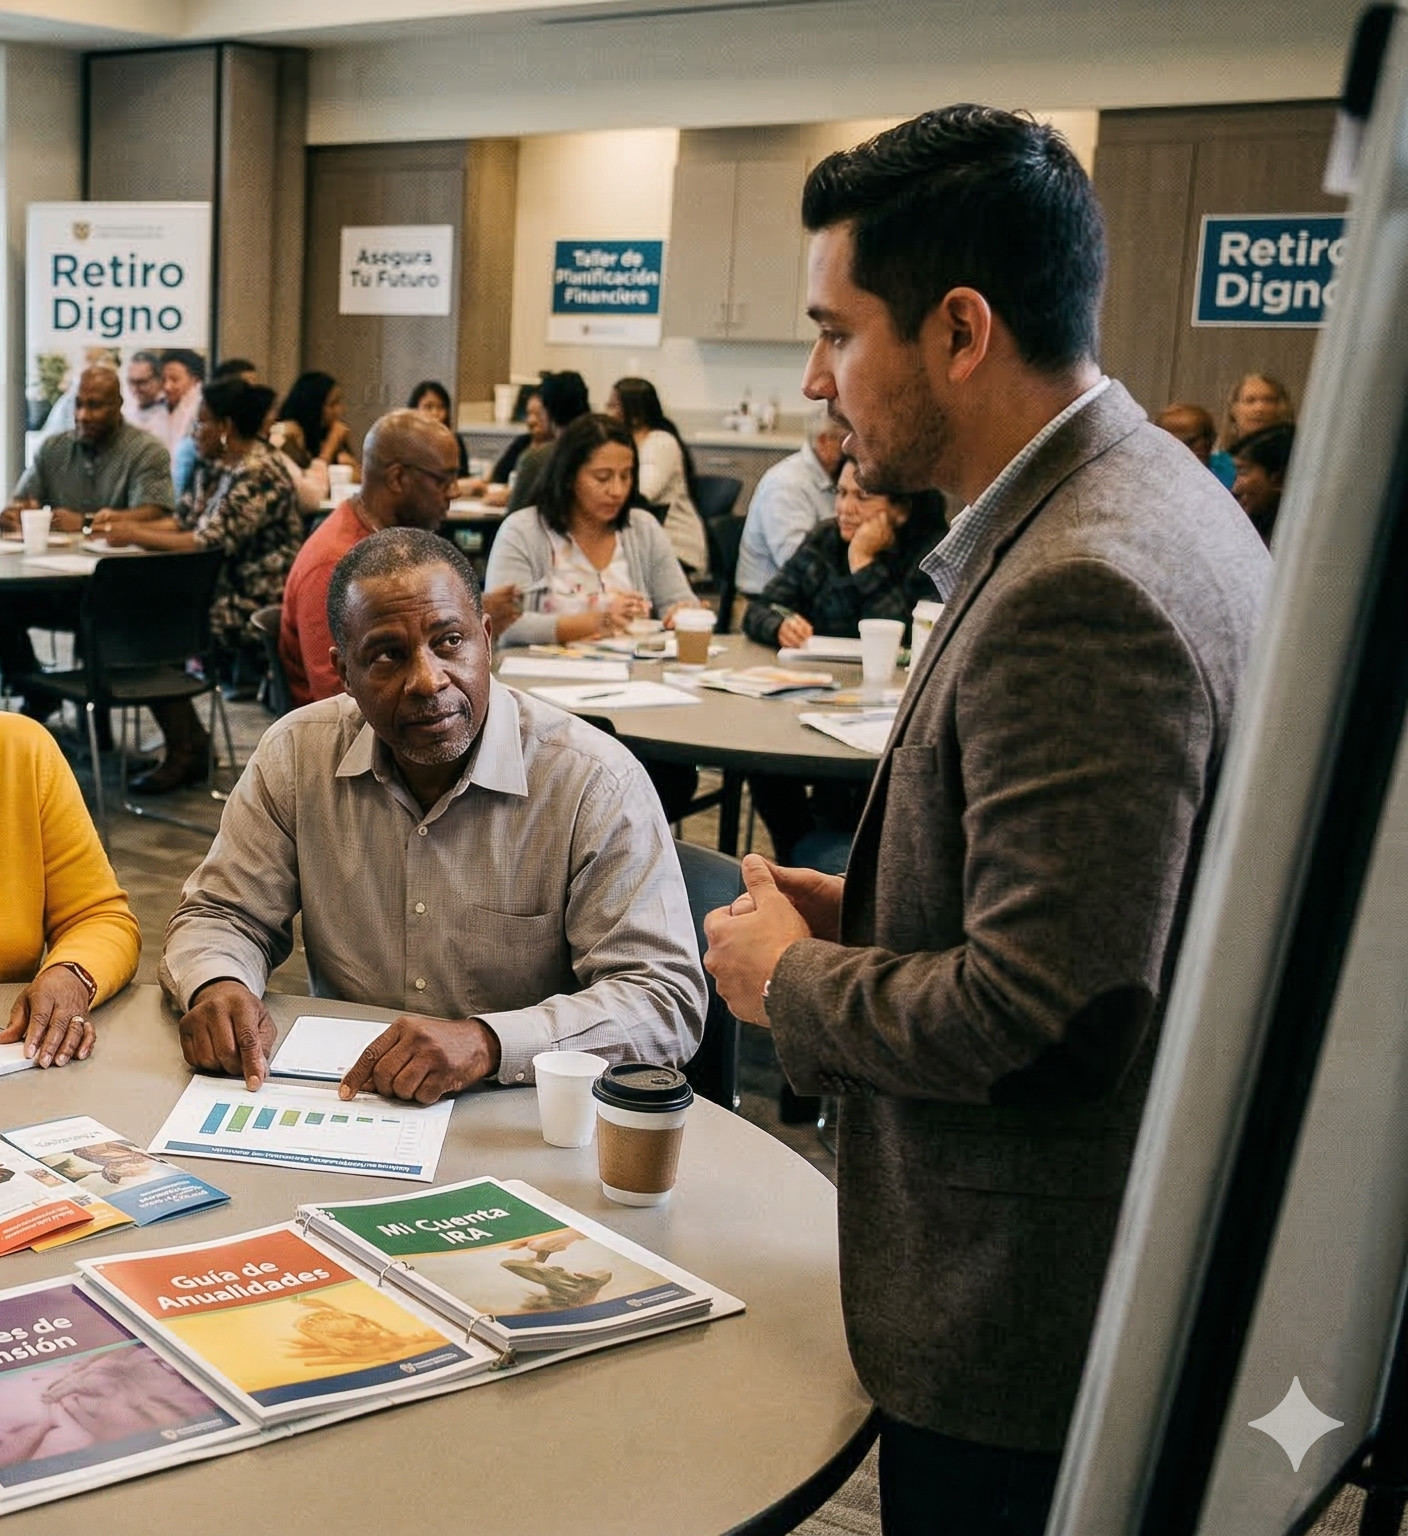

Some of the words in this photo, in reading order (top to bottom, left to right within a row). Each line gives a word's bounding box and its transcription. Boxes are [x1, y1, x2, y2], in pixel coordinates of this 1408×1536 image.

[358, 249, 432, 269] Asegura
[573, 249, 619, 268] Taller
[620, 248, 644, 268] de
[52, 253, 184, 288] Retiro
[351, 270, 371, 287] Tu
[377, 270, 439, 288] Futuro
[53, 297, 182, 338] Digno
[376, 1223, 417, 1237] Mi
[415, 1208, 511, 1231] Cuenta
[438, 1227, 494, 1245] IRA
[170, 1270, 241, 1290] Guía
[241, 1262, 280, 1277] de
[157, 1268, 331, 1311] Anualidades
[32, 1317, 73, 1334] de
